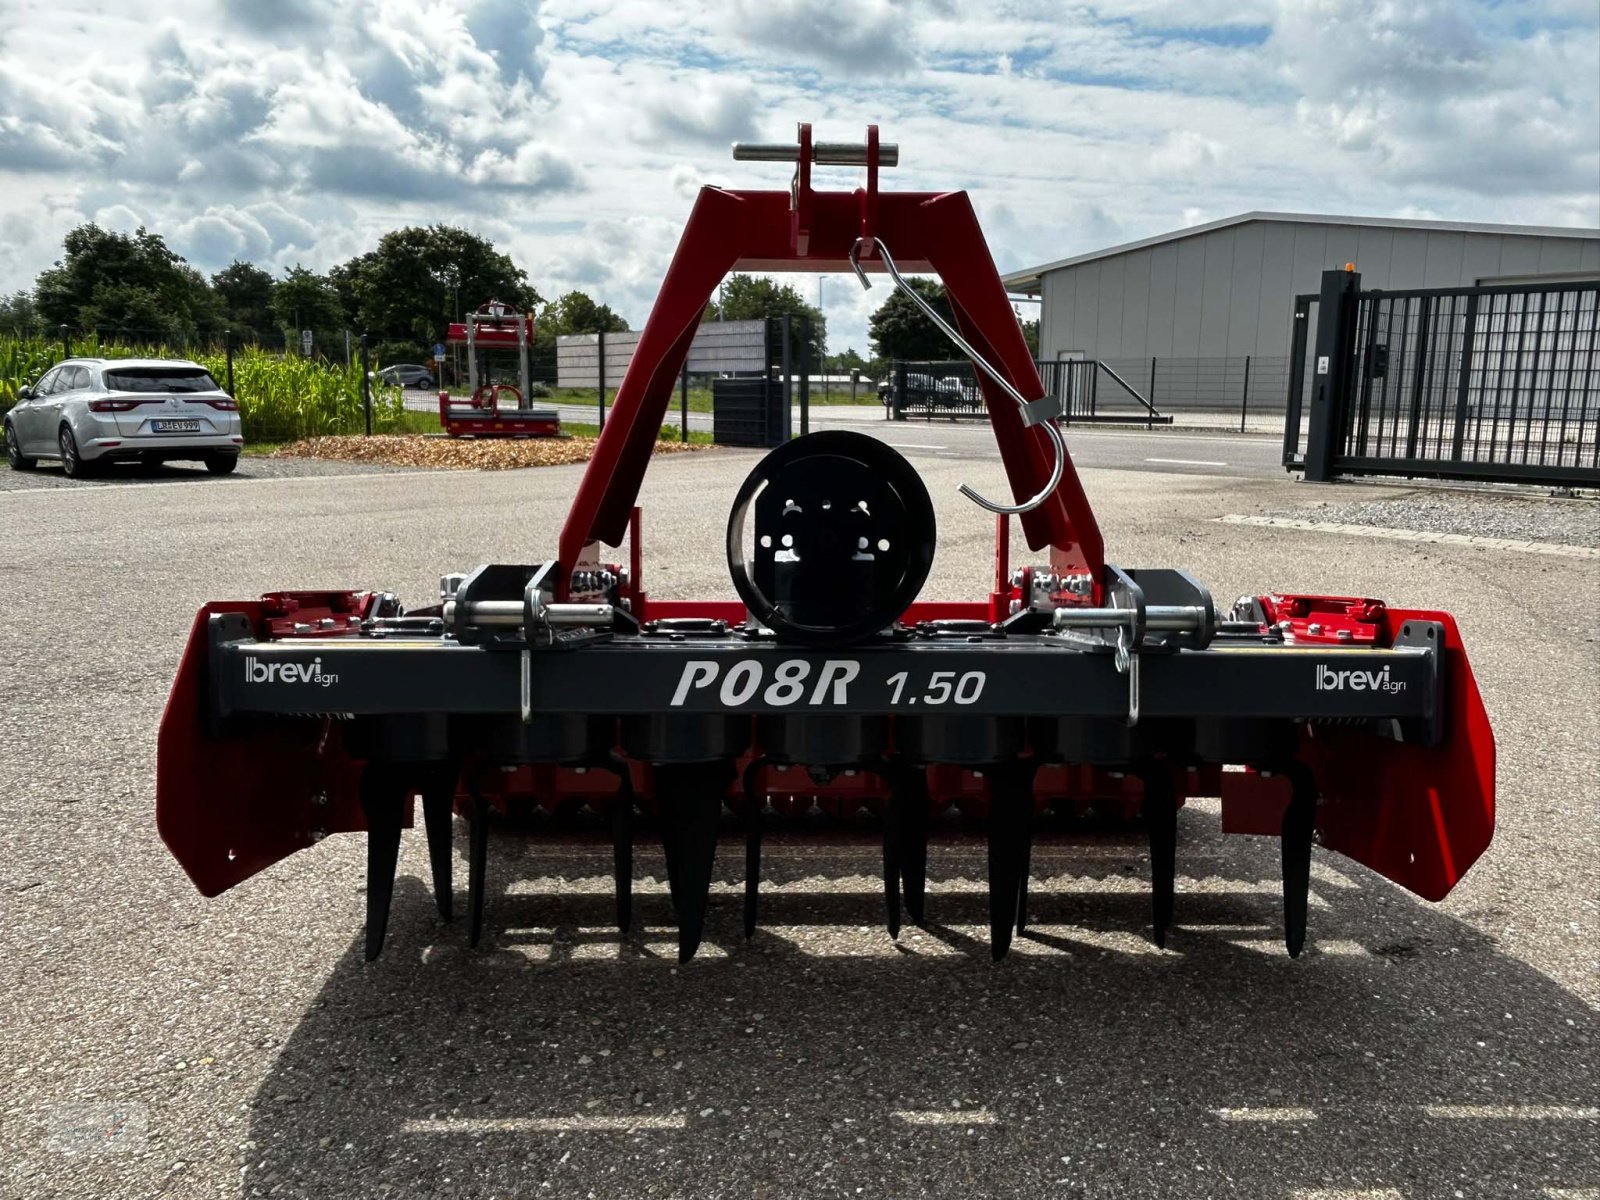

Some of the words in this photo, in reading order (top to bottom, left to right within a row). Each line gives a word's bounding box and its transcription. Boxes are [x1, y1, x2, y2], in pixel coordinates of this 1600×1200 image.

[245, 656, 322, 683] brevi
[314, 674, 339, 687] agri
[670, 659, 861, 706] P08R
[886, 671, 987, 705] 1.50
[1316, 664, 1390, 690] brevi
[1382, 681, 1407, 695] agri
